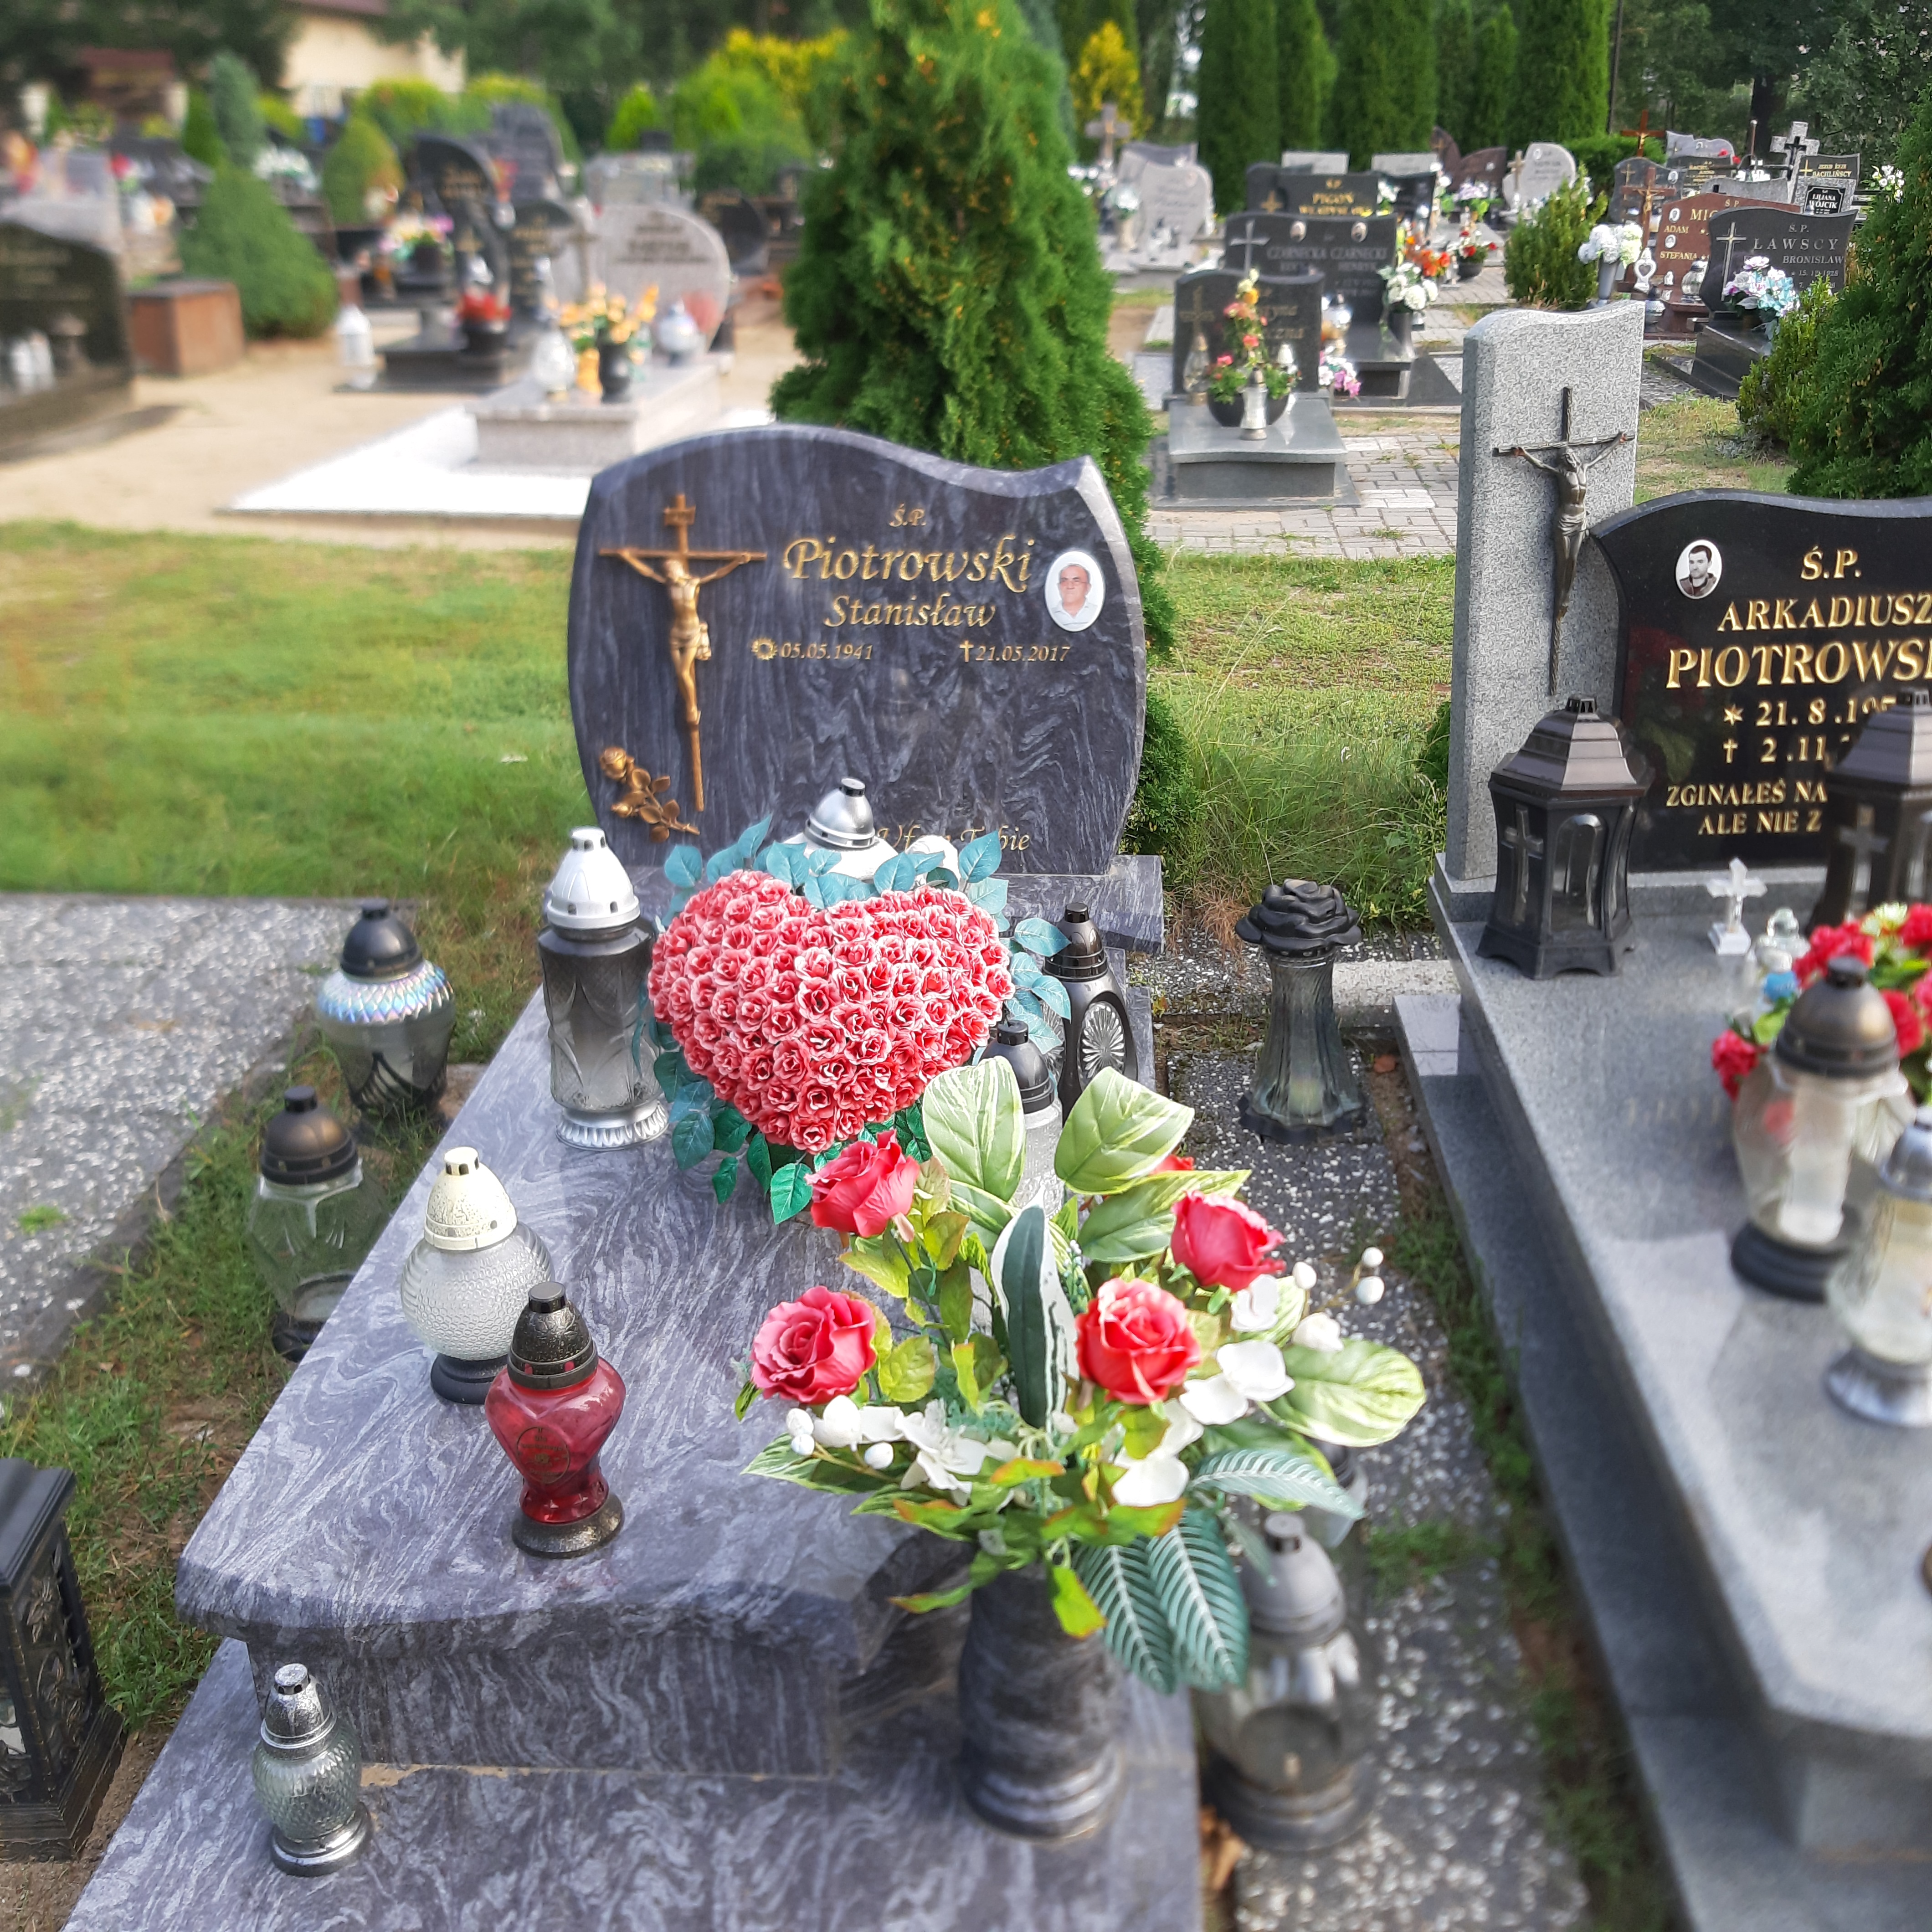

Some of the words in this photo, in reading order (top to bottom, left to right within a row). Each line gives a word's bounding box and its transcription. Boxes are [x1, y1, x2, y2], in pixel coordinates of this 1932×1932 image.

[1664, 225, 1689, 234] ADAM
[1660, 251, 1697, 261] STEFANIA
[889, 504, 927, 527] Ś.P.
[783, 534, 1035, 593] Piotrowski
[1800, 545, 1862, 581] Ś.P.
[823, 592, 997, 628] Stanisław
[1716, 592, 1932, 632] ARKADIUSZ
[781, 642, 873, 661] 05.05.1941
[975, 645, 1071, 663] 21.05.2017
[1794, 780, 1828, 803] NA
[1698, 811, 1747, 837] ALE
[1756, 810, 1799, 834] NIE
[1806, 810, 1822, 833] Z
[960, 825, 1030, 851] Tbie
